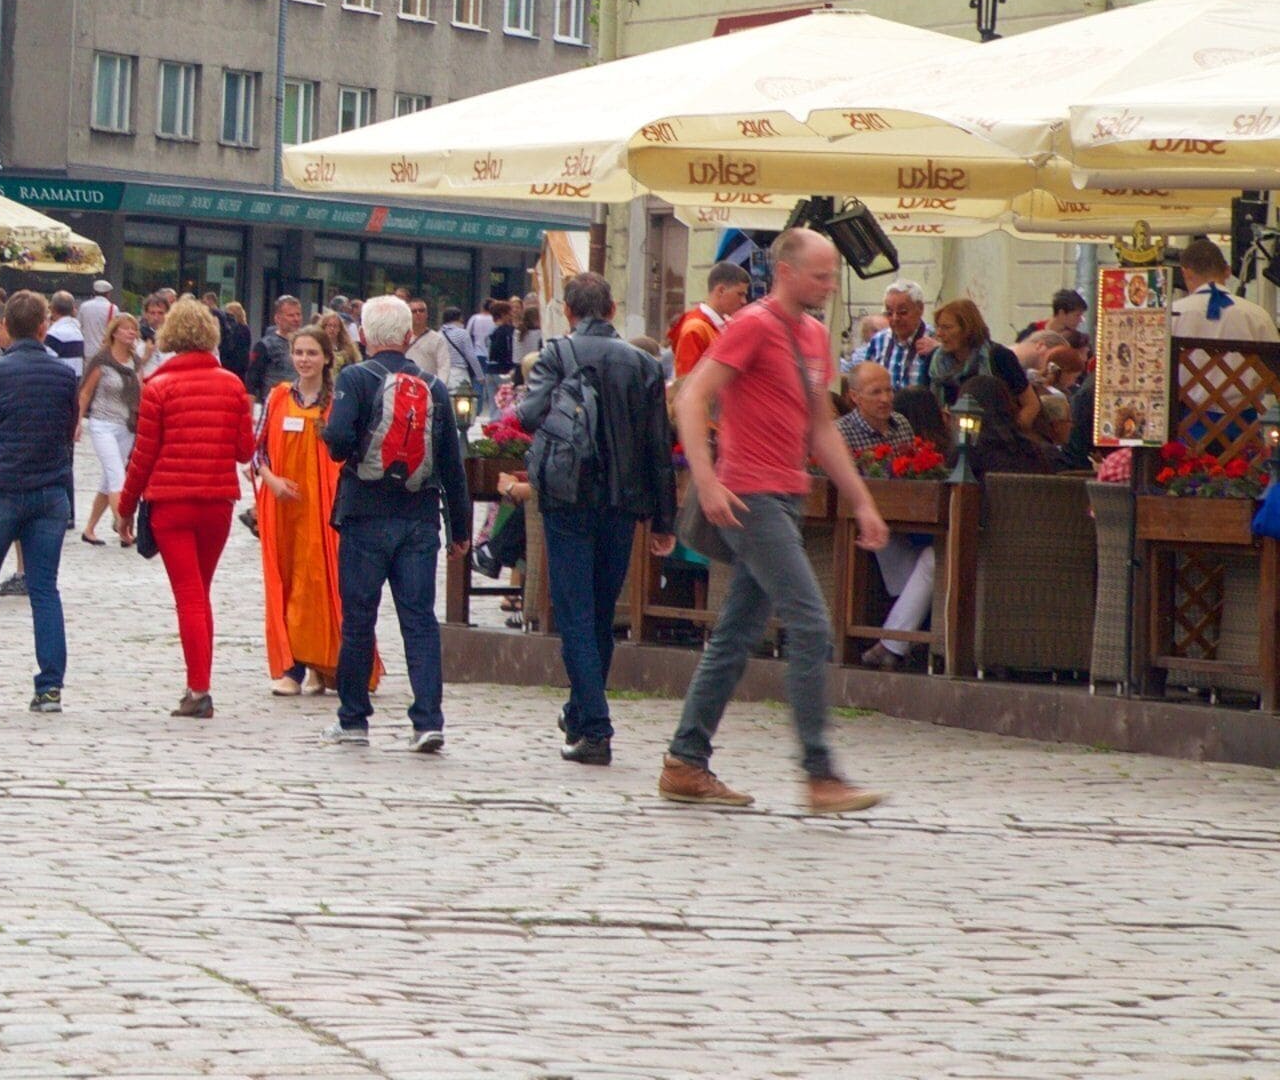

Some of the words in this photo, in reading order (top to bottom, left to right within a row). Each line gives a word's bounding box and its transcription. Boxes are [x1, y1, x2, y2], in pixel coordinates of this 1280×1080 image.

[304, 155, 336, 182] saku
[390, 155, 419, 183] saku
[472, 152, 503, 181] saku
[561, 148, 594, 176] saku
[19, 186, 105, 203] RAAMATUD
